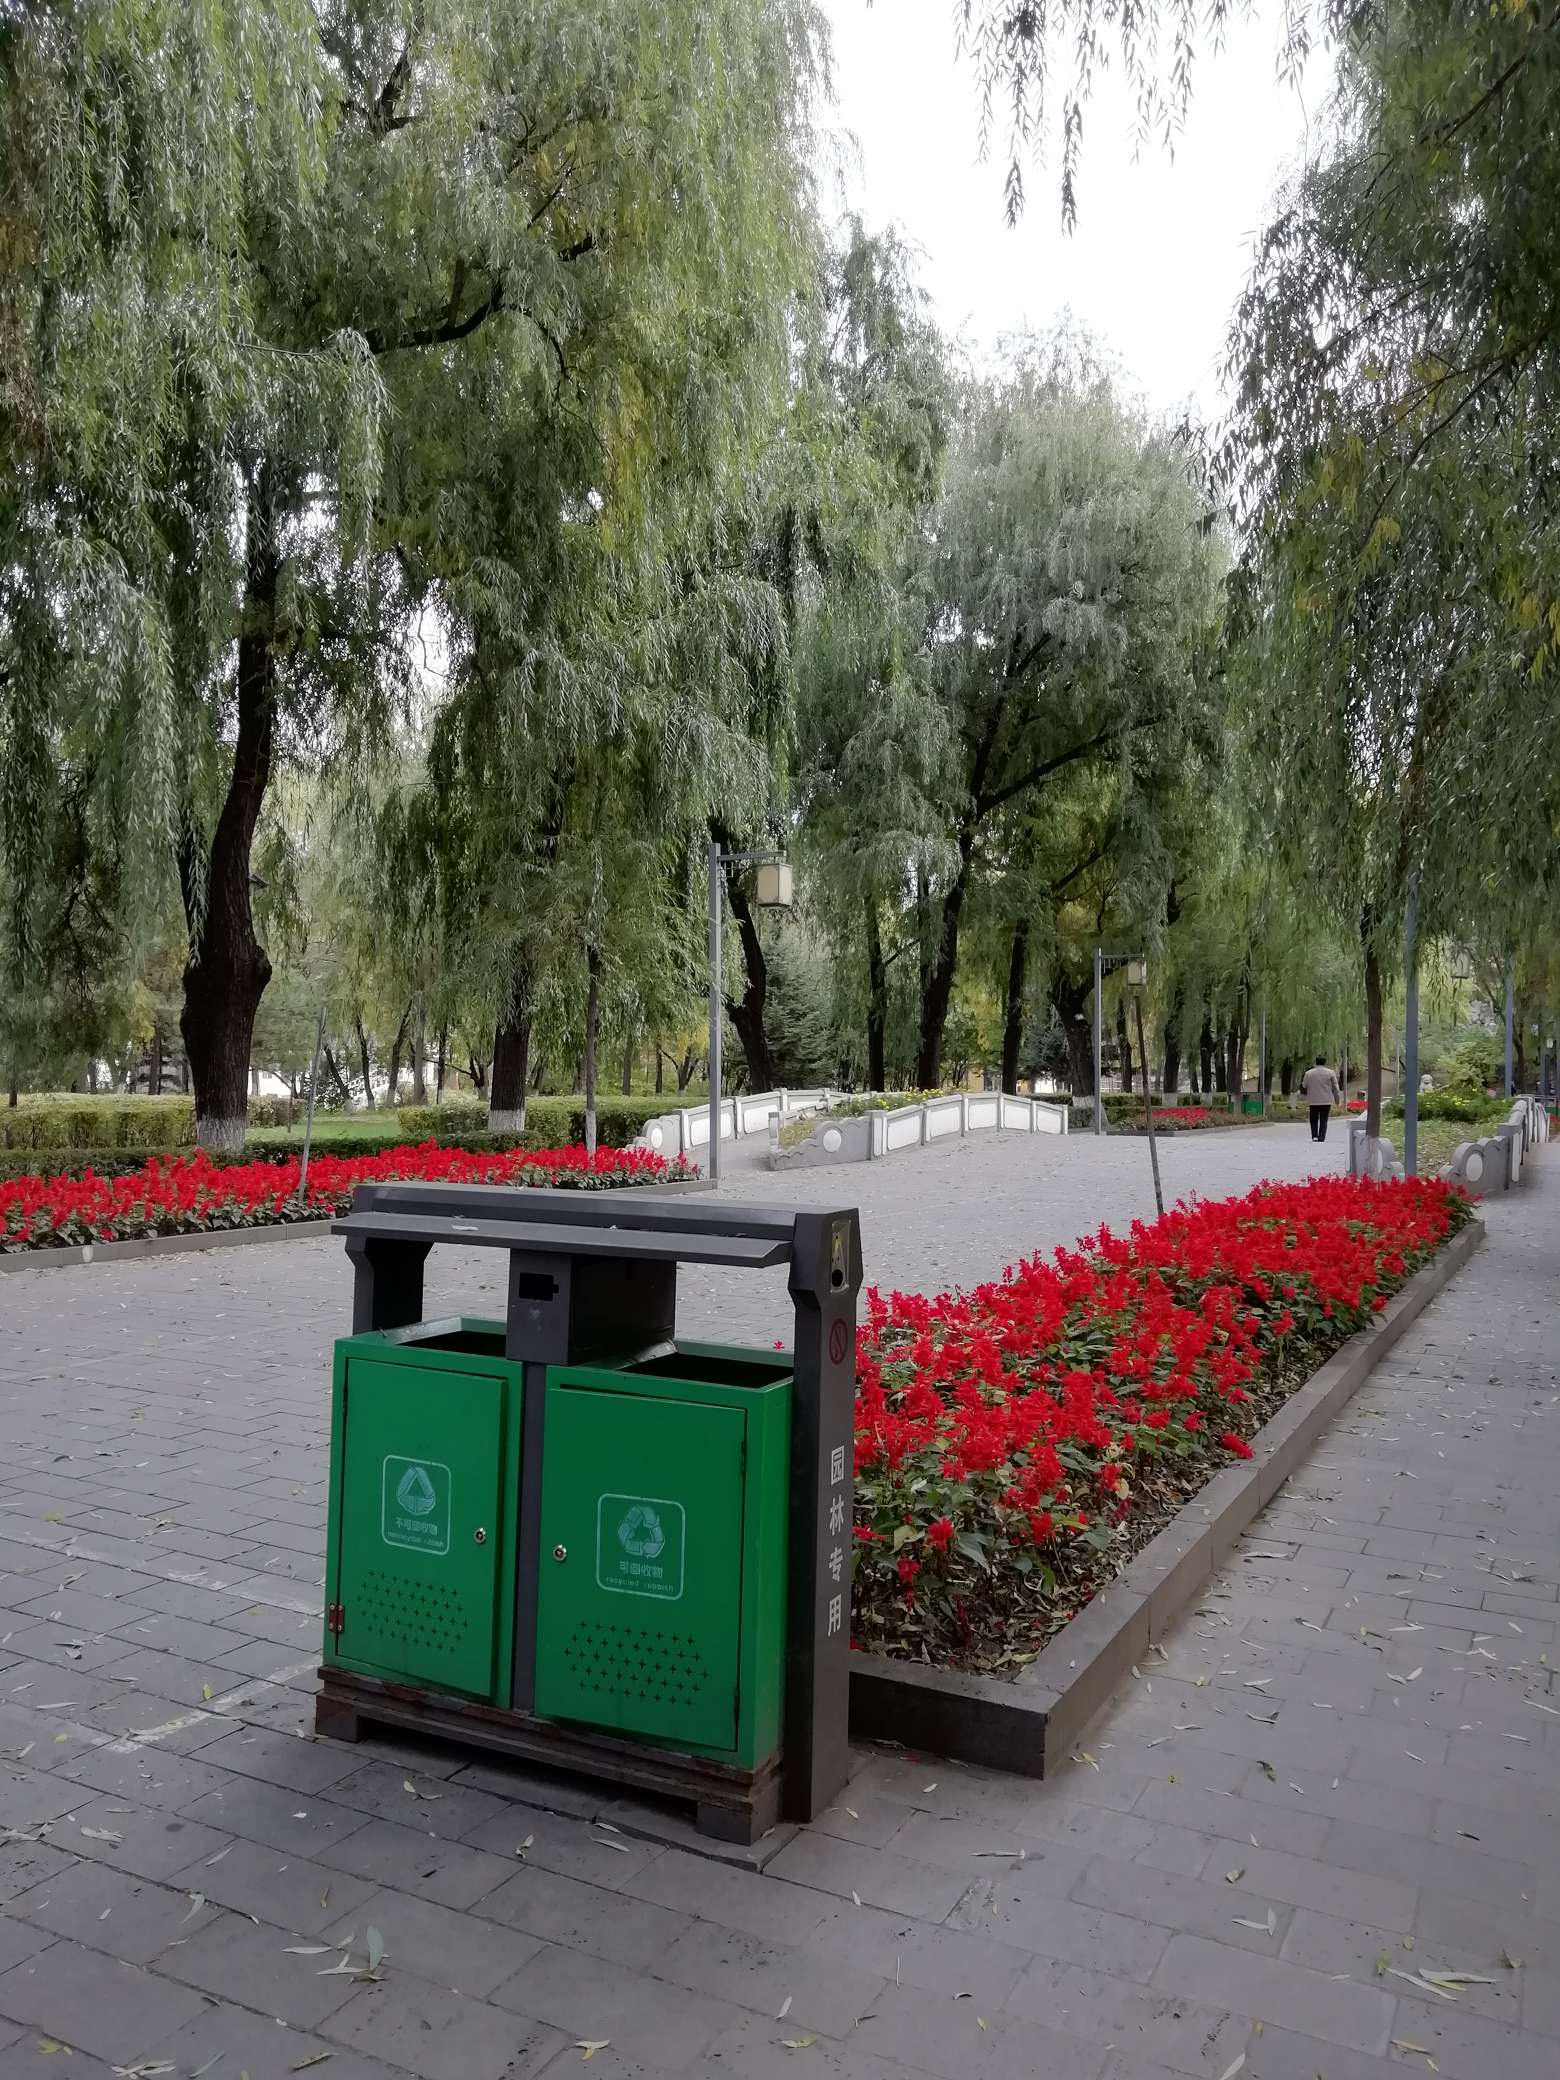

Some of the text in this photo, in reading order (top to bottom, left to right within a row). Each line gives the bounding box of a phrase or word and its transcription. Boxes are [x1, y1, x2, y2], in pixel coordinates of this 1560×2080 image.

[619, 1561, 663, 1578] 可回收物
[828, 1445, 845, 1637] 园林专用
